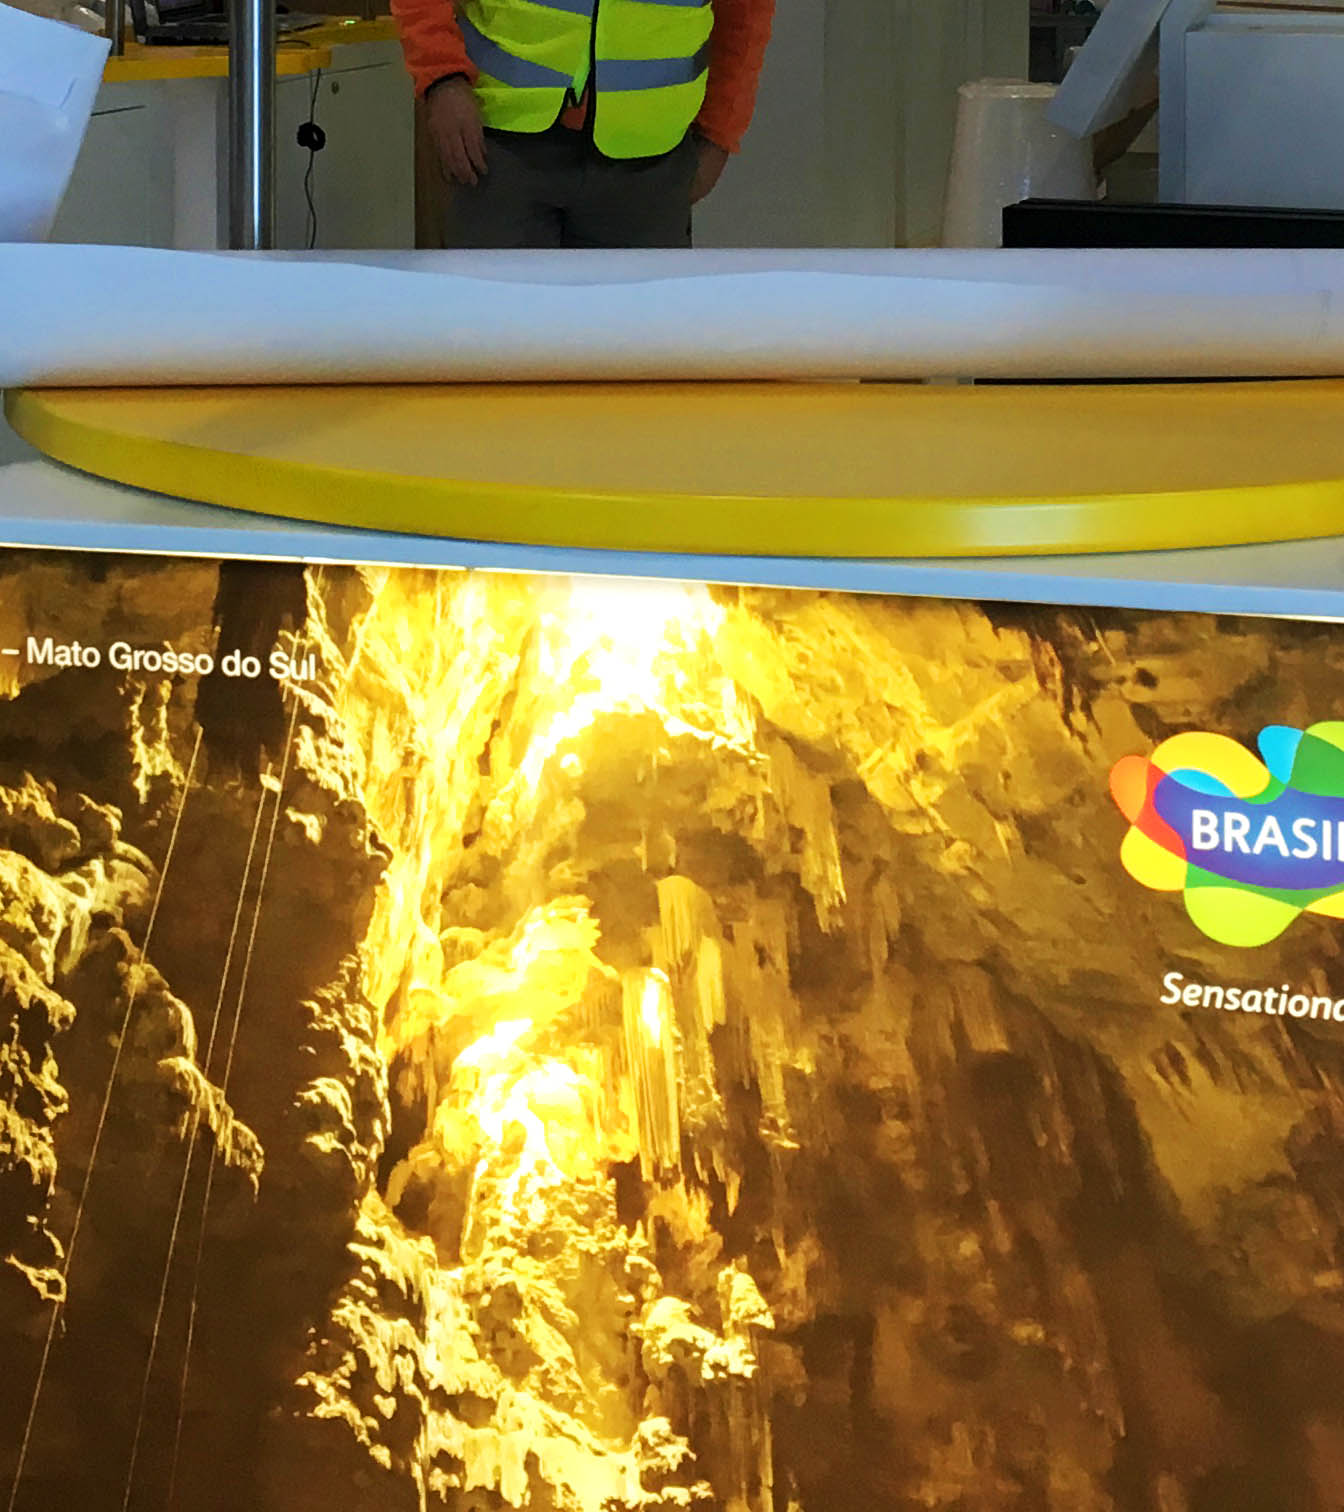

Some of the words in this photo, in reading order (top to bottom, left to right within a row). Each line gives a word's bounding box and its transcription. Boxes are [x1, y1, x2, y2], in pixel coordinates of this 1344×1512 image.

[27, 637, 102, 670] Mato
[109, 642, 214, 676] Grosso
[221, 648, 261, 678] do
[268, 651, 316, 682] Sul
